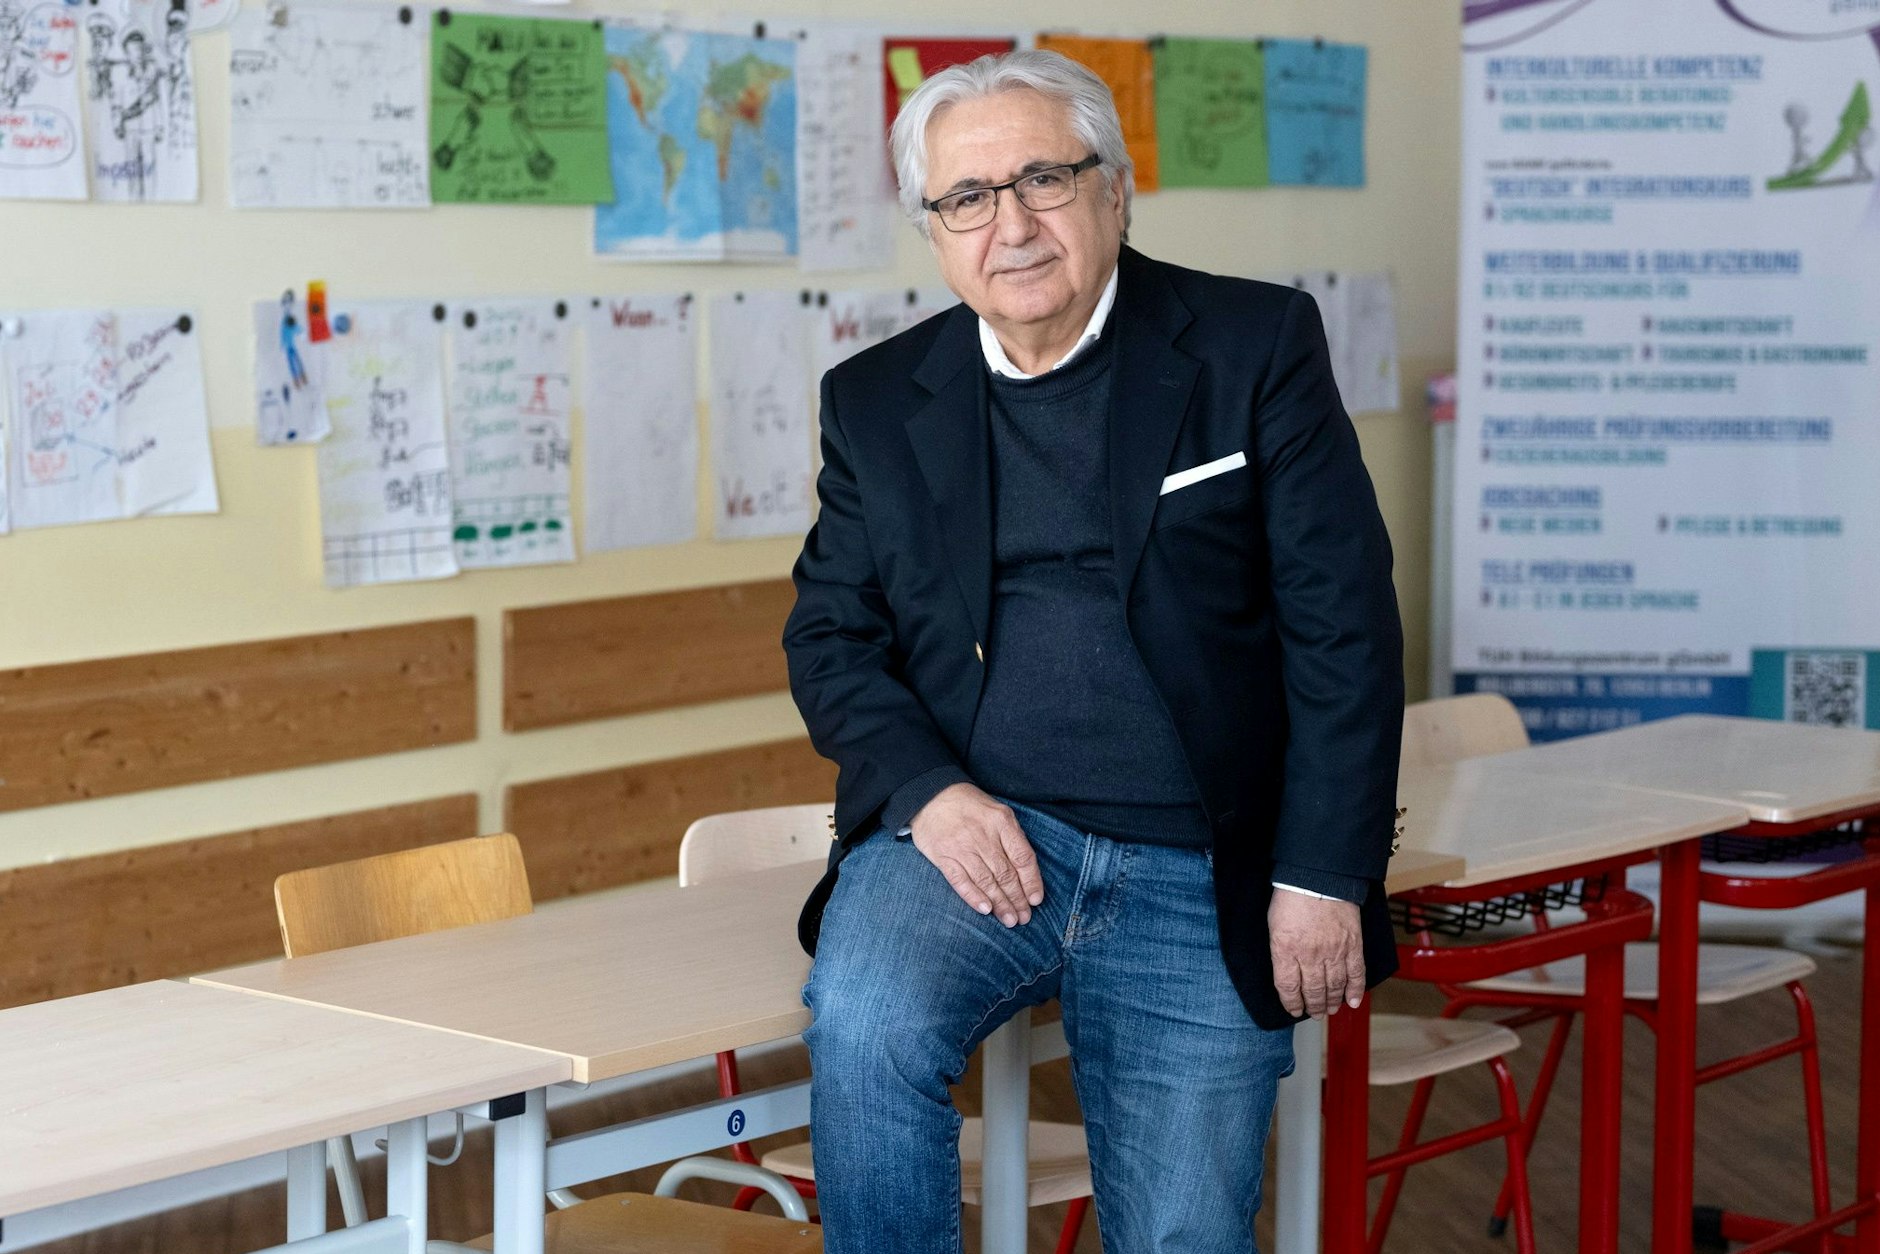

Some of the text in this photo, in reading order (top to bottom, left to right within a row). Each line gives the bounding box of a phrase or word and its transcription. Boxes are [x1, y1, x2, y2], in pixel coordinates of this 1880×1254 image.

[1654, 56, 1763, 79] KOMPETENZ
[1484, 250, 1631, 274] WEITERBILDUNG
[1653, 250, 1802, 275] QUALIFIZIERUNG
[731, 1114, 741, 1133] 6
